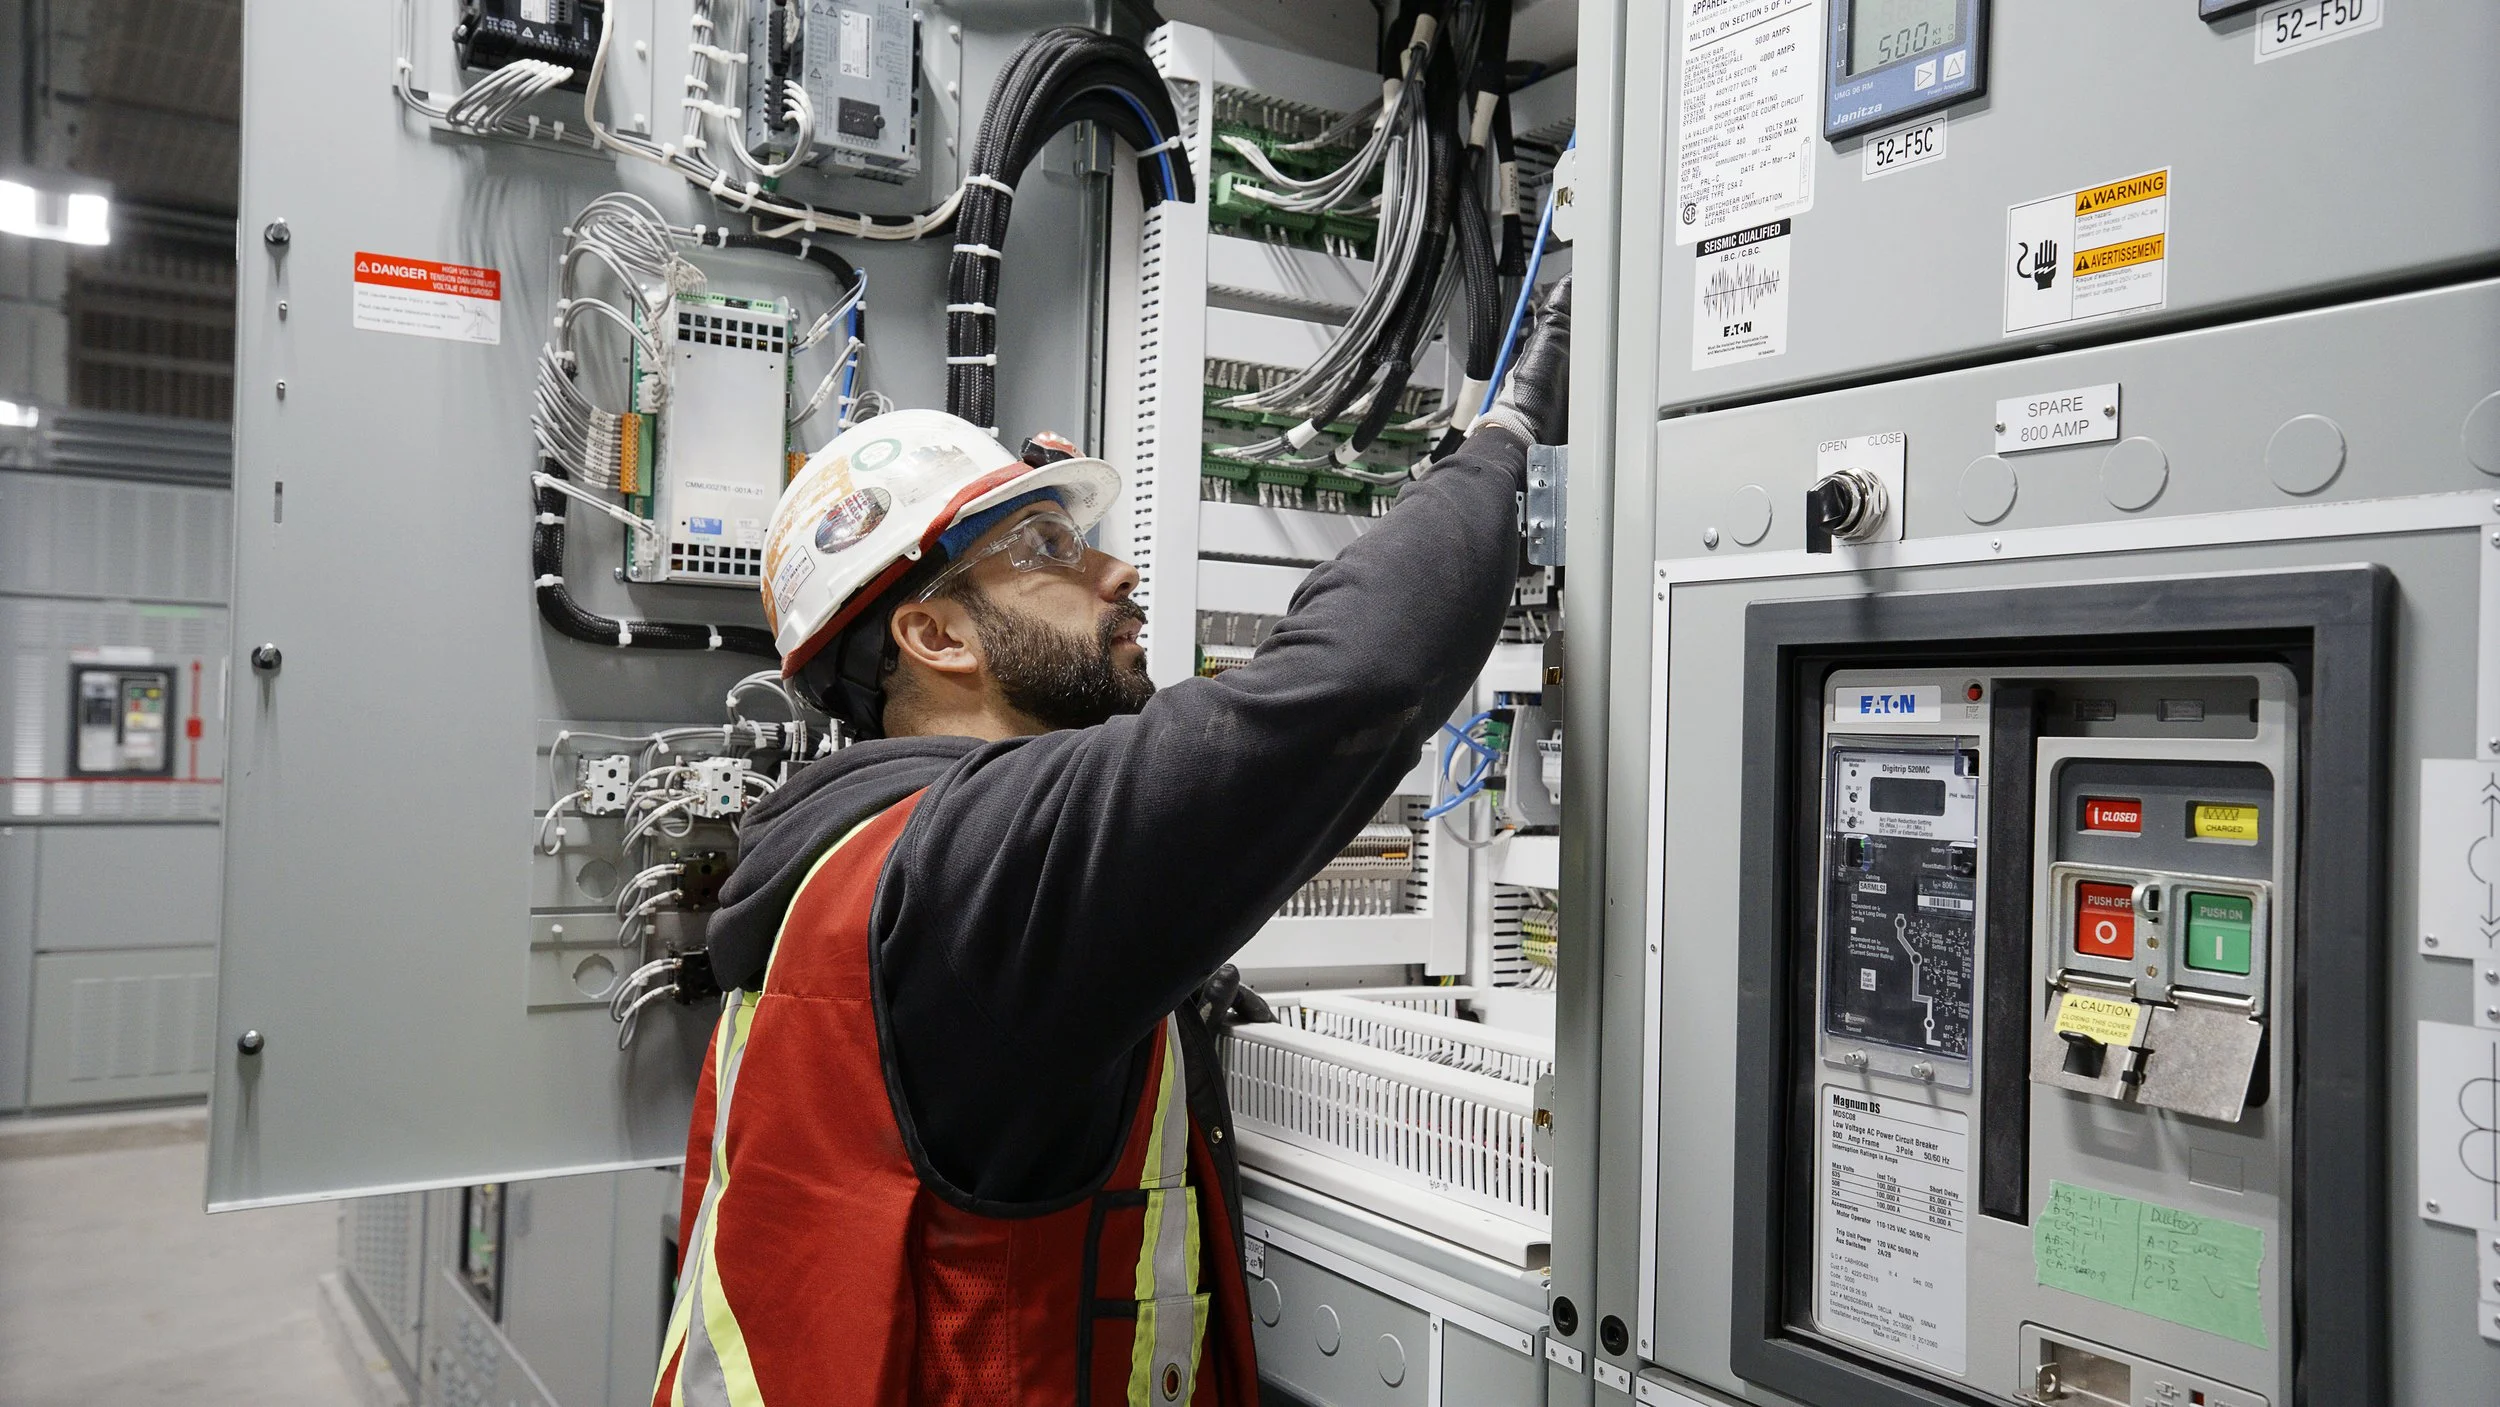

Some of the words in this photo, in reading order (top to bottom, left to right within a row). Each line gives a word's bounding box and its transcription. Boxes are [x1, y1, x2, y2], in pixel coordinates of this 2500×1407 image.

[1720, 20, 1729, 30] ON
[1732, 8, 1762, 26] SECTION
[1764, 4, 1769, 13] 5
[1771, 26, 1791, 39] AMPS
[1838, 23, 1847, 32] L2
[1932, 27, 1941, 36] K1
[1776, 43, 1796, 57] AMPS
[1878, 21, 1929, 65] 500
[1932, 37, 1942, 46] K2
[1713, 47, 1724, 56] BAR
[1733, 65, 1757, 79] SECTION
[1834, 88, 1851, 101] UMG
[1852, 86, 1861, 96] 96
[1862, 81, 1874, 93] RM
[1760, 101, 1779, 115] COURT
[1781, 94, 1804, 108] CIRCUIT
[1833, 103, 1883, 126] Janitza
[1765, 120, 1784, 134] VOLTS
[1758, 132, 1782, 144] TENSION
[1876, 126, 1934, 167] 52-F5C
[1741, 164, 1755, 175] DATE
[2094, 176, 2164, 206] WARNING
[1704, 206, 1731, 220] APPAREIL
[1732, 203, 1739, 212] DE
[1740, 192, 1783, 210] COMMUTATION
[1705, 196, 1740, 213] SWITCHGEAR
[1741, 192, 1755, 203] UNIT
[1704, 232, 1737, 254] SEISMIC
[1738, 223, 1781, 245] QUALIFIED
[1720, 252, 1737, 262] I.B.C.
[1741, 246, 1761, 258] C.B.C.
[2091, 240, 2161, 268] AVERTISSEMENT
[371, 262, 427, 280] DANGER
[1723, 321, 1752, 337] EATON
[2027, 396, 2084, 418] SPARE
[2021, 424, 2048, 442] 800
[2051, 419, 2090, 438] AMP
[1819, 439, 1848, 453] OPEN
[1867, 433, 1901, 447] CLOSE
[1860, 694, 1915, 714] EATON
[1882, 764, 1906, 775] Digitrip
[1908, 764, 1931, 774] 520MC
[1918, 819, 1931, 827] Setting
[2102, 811, 2138, 823] CLOSED
[1902, 829, 1918, 837] External
[2205, 824, 2243, 834] CHARGED
[1942, 881, 1952, 889] 800
[2088, 895, 2112, 907] PUSH
[2113, 897, 2131, 908] OFF
[2200, 906, 2227, 919] PUSH
[2228, 909, 2243, 920] ON
[2080, 1000, 2133, 1017] CAUTION
[2059, 1021, 2076, 1030] WILL
[2077, 1023, 2095, 1033] OPEN
[2095, 1027, 2129, 1039] BREAKER
[2061, 1013, 2090, 1025] CLOSING
[2091, 1018, 2108, 1028] THIS
[2108, 1020, 2132, 1031] COVER
[1833, 1094, 1868, 1111] Magnum
[1869, 1101, 1881, 1114] DS
[1832, 1119, 1844, 1129] Low
[1845, 1122, 1866, 1135] Voltage
[1867, 1127, 1875, 1136] AC
[1876, 1130, 1894, 1140] Power
[1895, 1134, 1914, 1145] Circuit
[1915, 1138, 1938, 1150] Breaker
[1831, 1142, 1859, 1155] Interruption
[1860, 1149, 1878, 1160] Ratings
[1884, 1155, 1898, 1164] Amps
[1832, 1130, 1843, 1139] 800
[1848, 1134, 1861, 1144] Amp
[1862, 1137, 1880, 1148] Frame
[1900, 1146, 1913, 1156] Pole
[1923, 1152, 1941, 1163] 50/60
[1941, 1156, 1950, 1165] Hz
[1831, 1162, 1842, 1170] Max
[1842, 1164, 1855, 1173] Volts
[1886, 1174, 1897, 1183] Trip
[1929, 1185, 1943, 1196] Short
[1943, 1188, 1959, 1199] Delay
[1831, 1200, 1859, 1212] Accessories
[1836, 1210, 1850, 1219] Motor
[1850, 1212, 1872, 1224] Operator
[1897, 1227, 1907, 1235] VAC
[1924, 1233, 1931, 1241] Hz
[1836, 1228, 1845, 1237] Trip
[1846, 1230, 1856, 1239] Unit
[1857, 1233, 1872, 1244] Power
[1887, 1242, 1897, 1251] VAC
[1836, 1236, 1845, 1245] Aux
[1845, 1239, 1866, 1251] Switches
